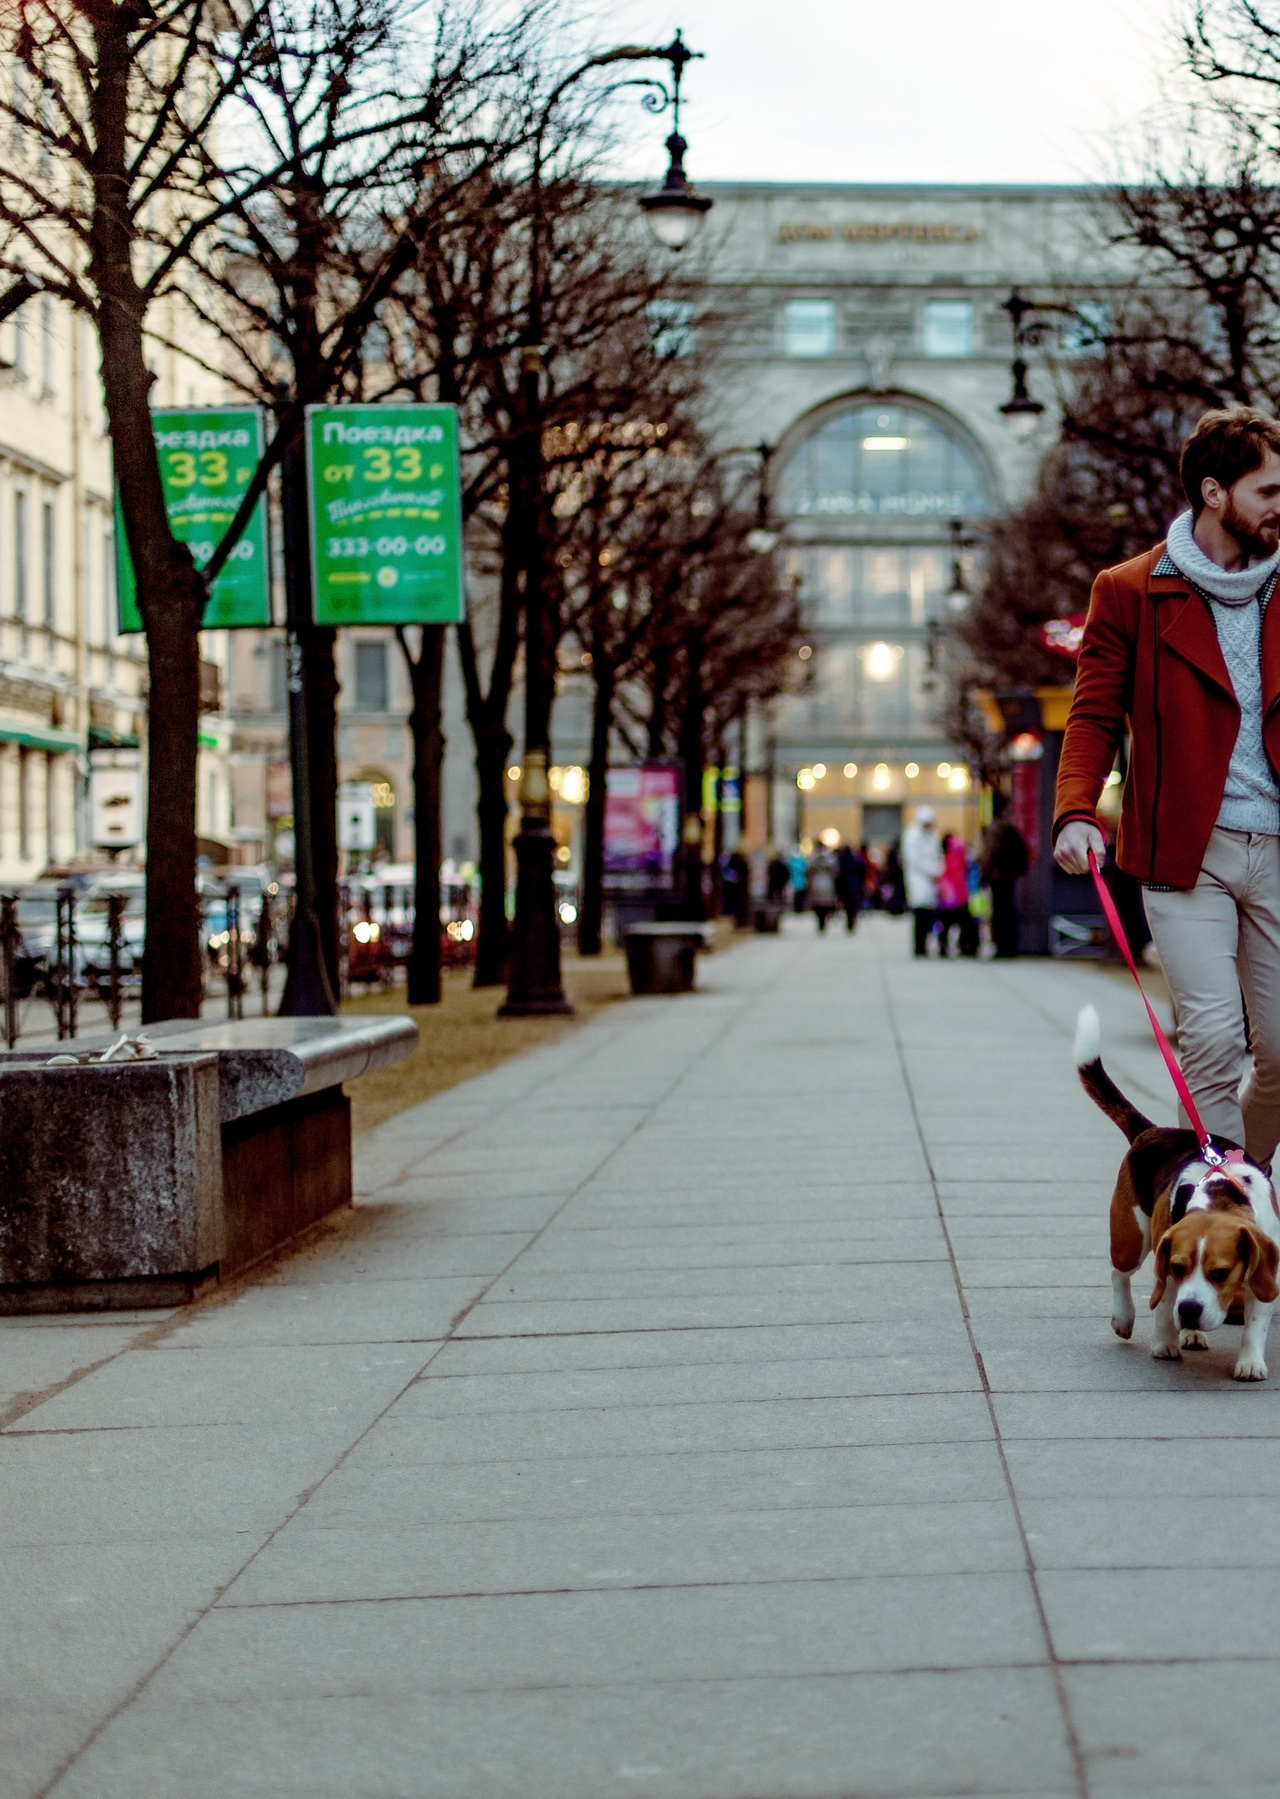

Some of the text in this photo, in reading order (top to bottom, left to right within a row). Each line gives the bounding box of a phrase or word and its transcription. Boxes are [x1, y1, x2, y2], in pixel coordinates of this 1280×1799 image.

[153, 430, 249, 450] оездка
[323, 422, 444, 446] Поездка
[167, 451, 228, 487] 33
[324, 464, 355, 483] от
[363, 446, 423, 483] 33
[328, 535, 446, 558] 333-00-00
